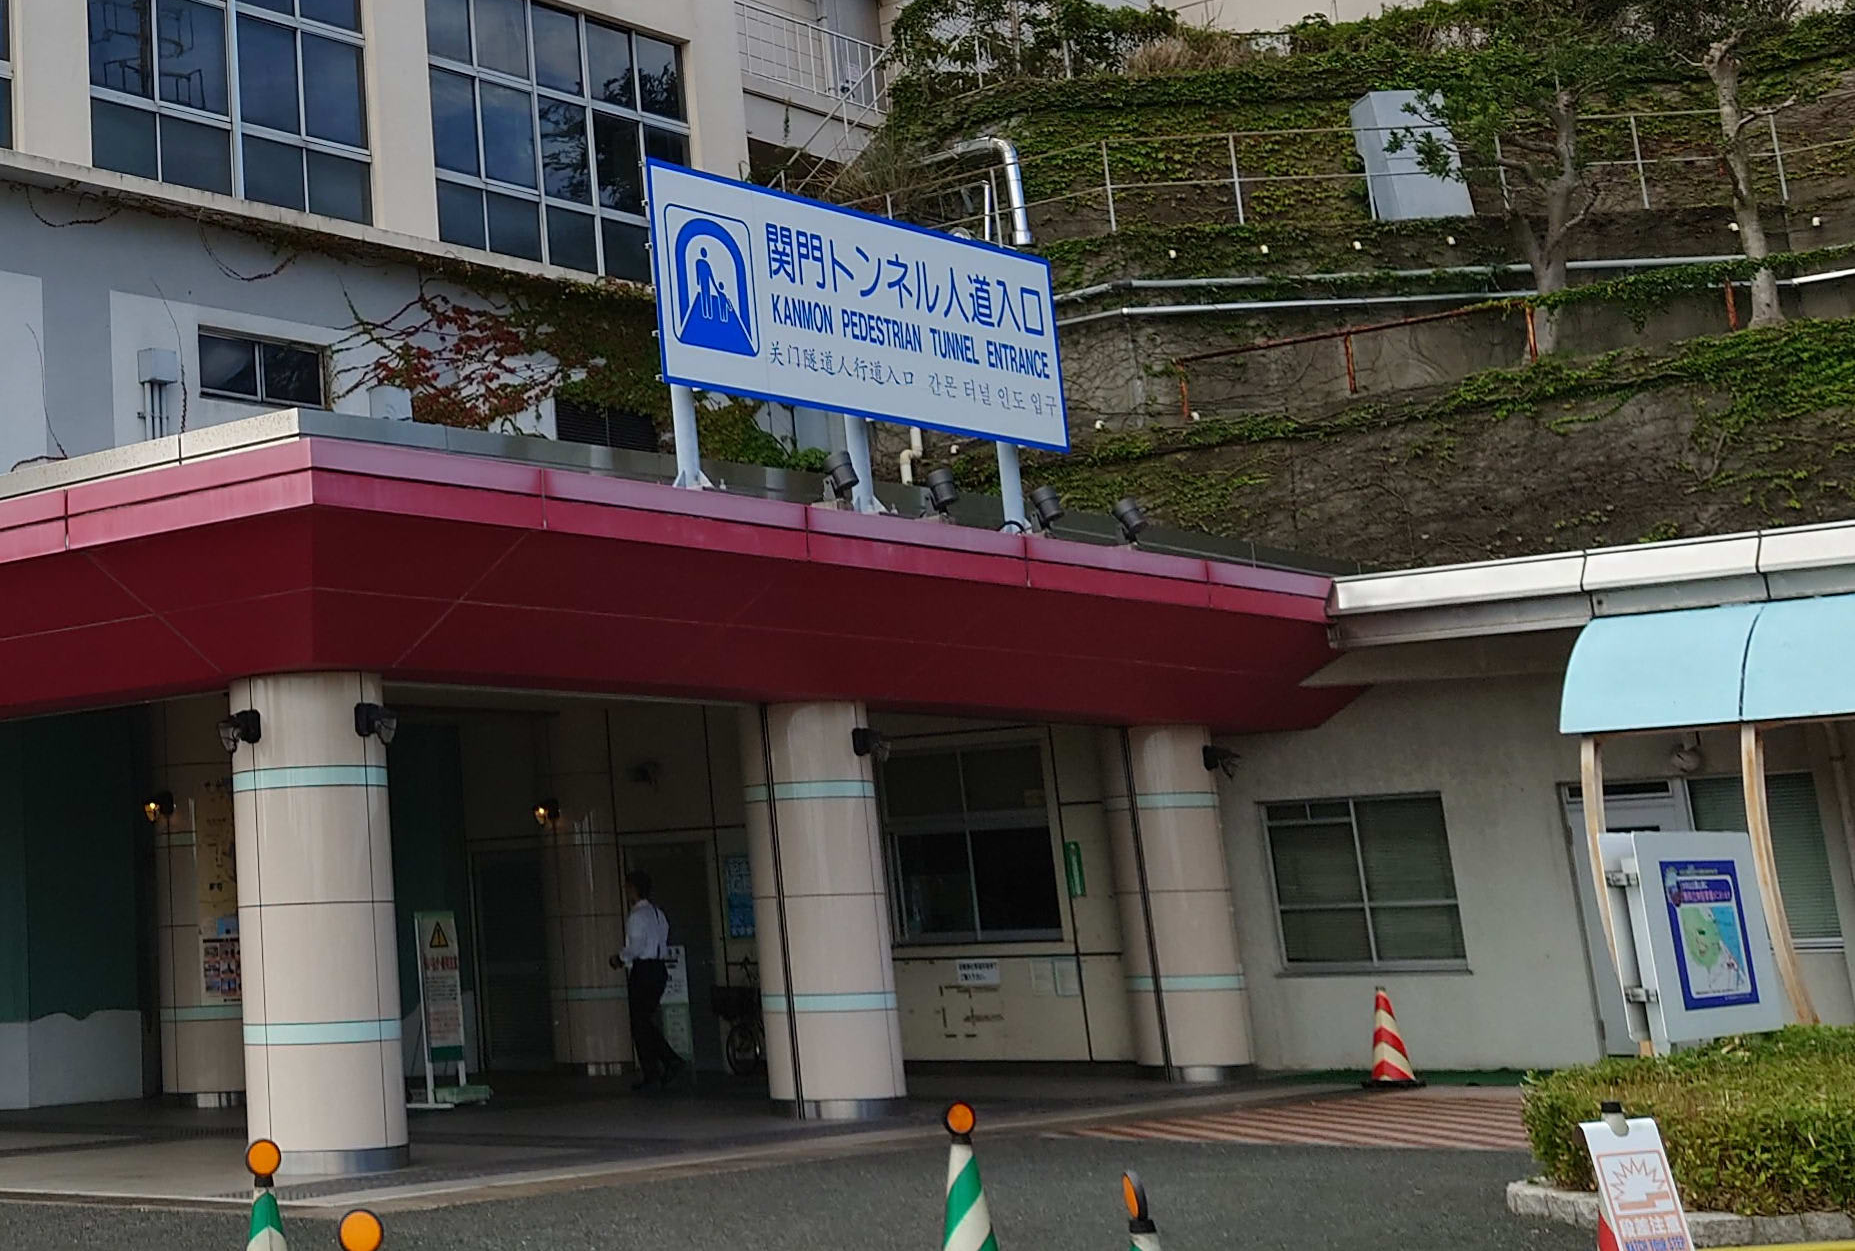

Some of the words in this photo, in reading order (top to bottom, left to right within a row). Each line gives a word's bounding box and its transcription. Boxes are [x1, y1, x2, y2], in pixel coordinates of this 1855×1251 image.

[765, 222, 1045, 337] 関門トンネル人道入口
[769, 341, 915, 385] 关门隧道人行道入口
[771, 293, 834, 336] KANMON
[841, 308, 923, 354] PEDESTRIAN
[929, 327, 980, 365] TUNNEL
[986, 340, 1051, 380] ENTRANCE
[928, 372, 958, 399] 간몬
[963, 379, 992, 406] 터널
[997, 386, 1026, 410] 인도
[1030, 392, 1057, 417] 입구
